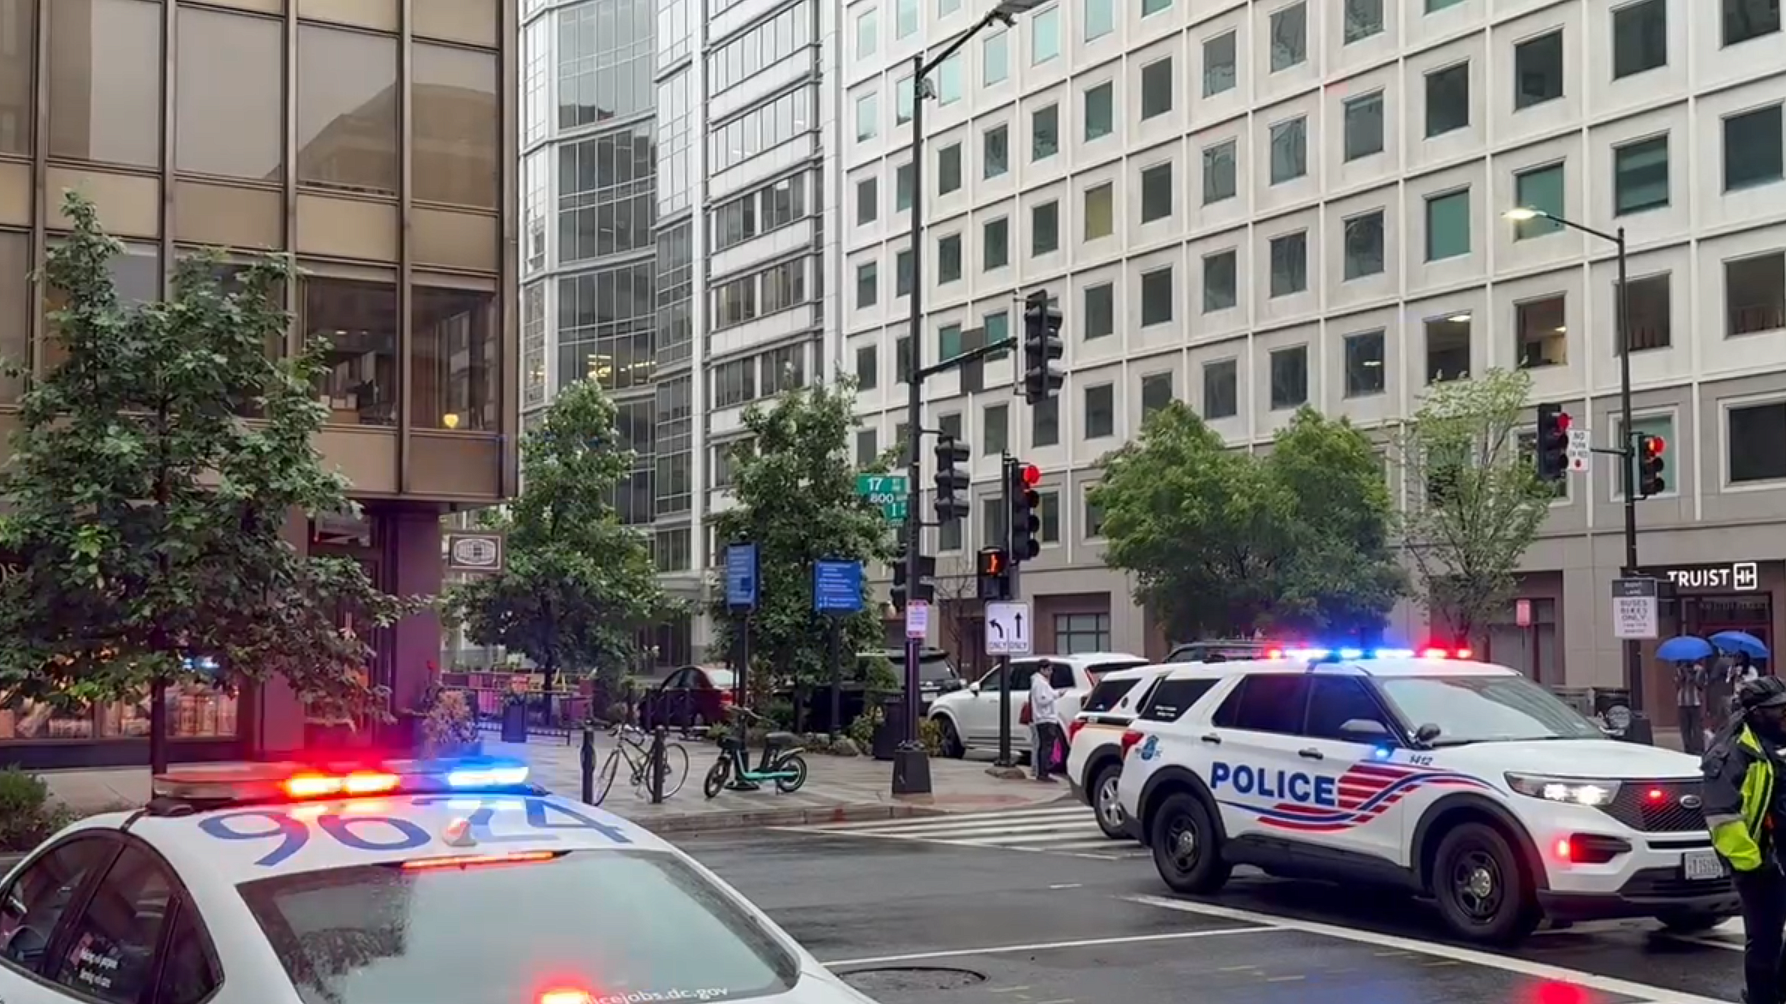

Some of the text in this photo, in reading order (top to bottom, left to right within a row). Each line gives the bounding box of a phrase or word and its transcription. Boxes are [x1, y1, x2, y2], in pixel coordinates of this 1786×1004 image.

[867, 477, 882, 490] 17
[870, 493, 894, 503] 800
[1667, 568, 1731, 588] TRUIST
[1210, 761, 1336, 808] POLICE
[198, 797, 632, 867] 9624
[585, 986, 728, 1004] licejobs.dc.gov
